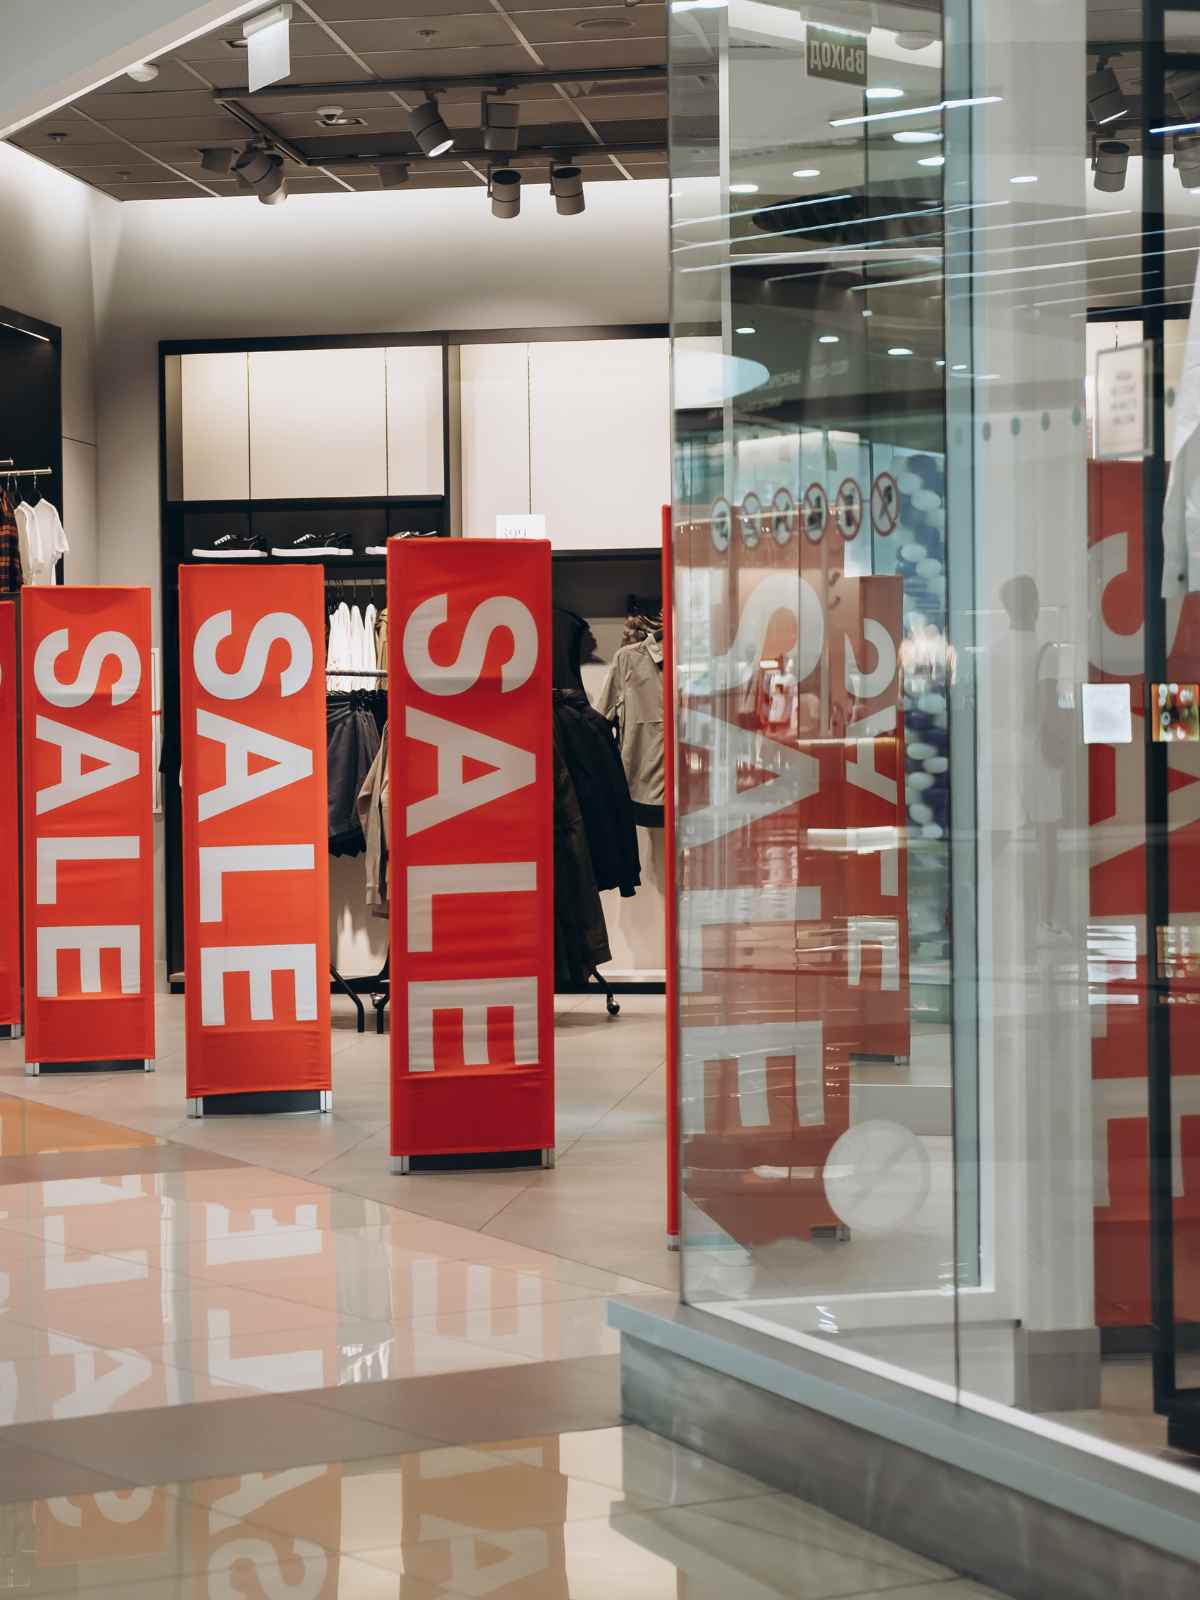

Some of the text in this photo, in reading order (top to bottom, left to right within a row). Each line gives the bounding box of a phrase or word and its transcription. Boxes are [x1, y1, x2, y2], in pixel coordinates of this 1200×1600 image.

[33, 628, 141, 998] SALE
[193, 609, 319, 1026] SALE
[403, 594, 539, 1073] SALE
[676, 571, 825, 1135] SALE
